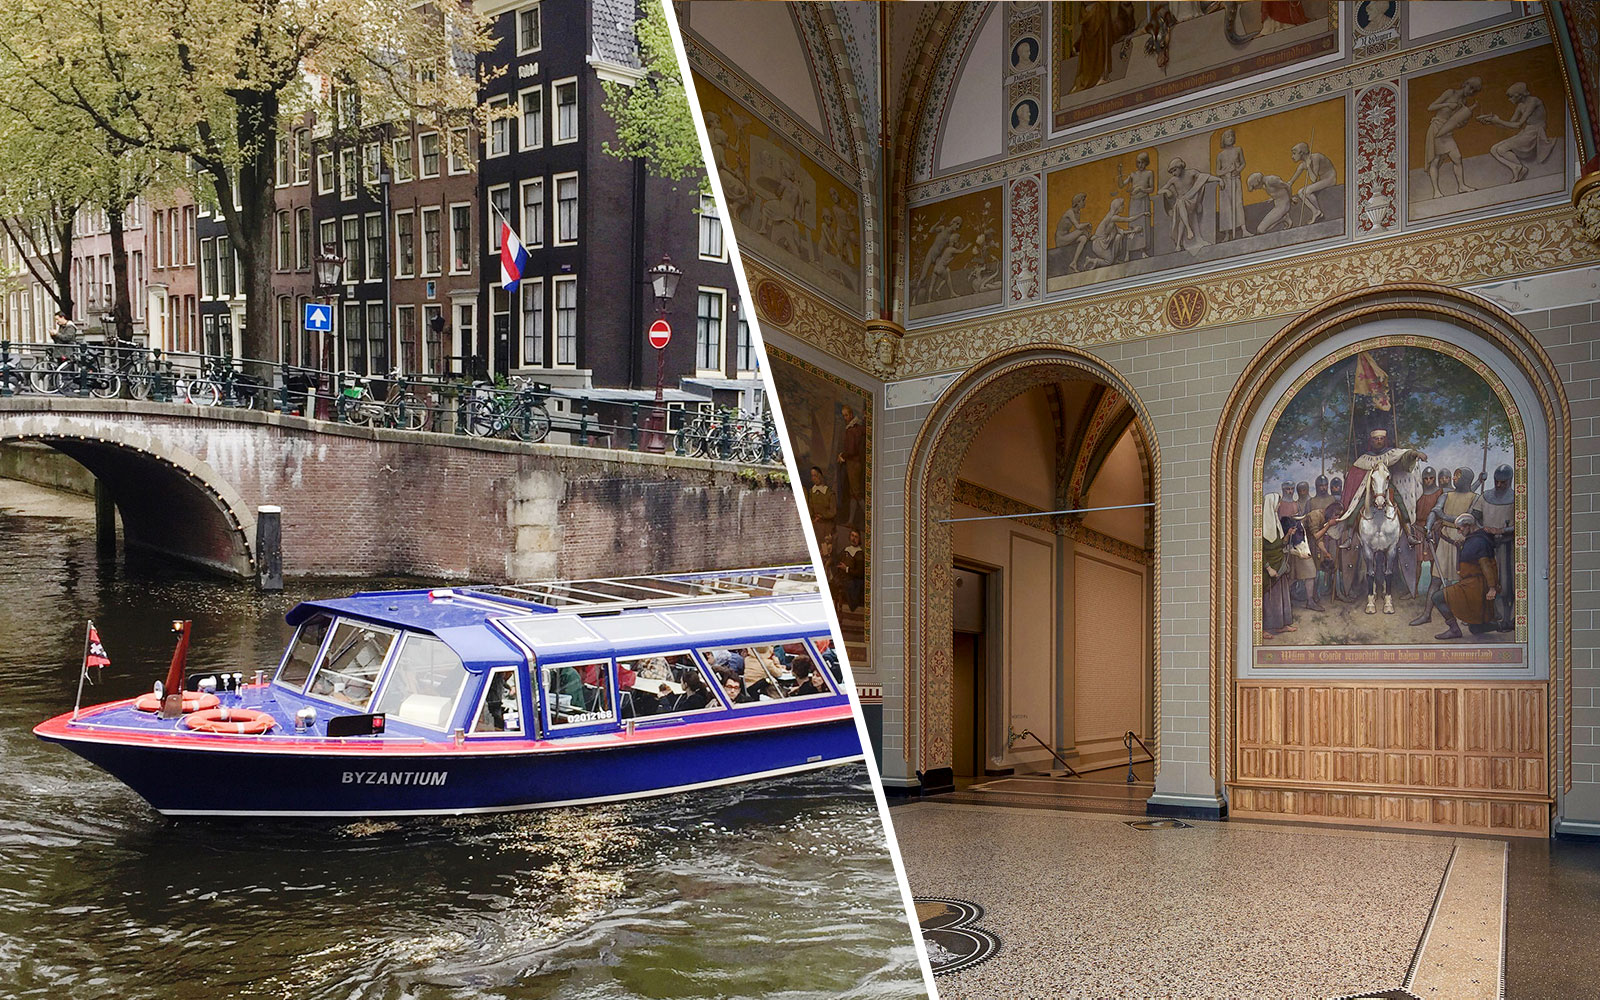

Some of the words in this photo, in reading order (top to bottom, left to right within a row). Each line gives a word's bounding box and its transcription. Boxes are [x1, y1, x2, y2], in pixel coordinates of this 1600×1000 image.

[1319, 650, 1342, 661] Goede
[1383, 650, 1395, 661] den
[567, 710, 612, 723] 02012168
[341, 771, 448, 786] BYZANTIUM
